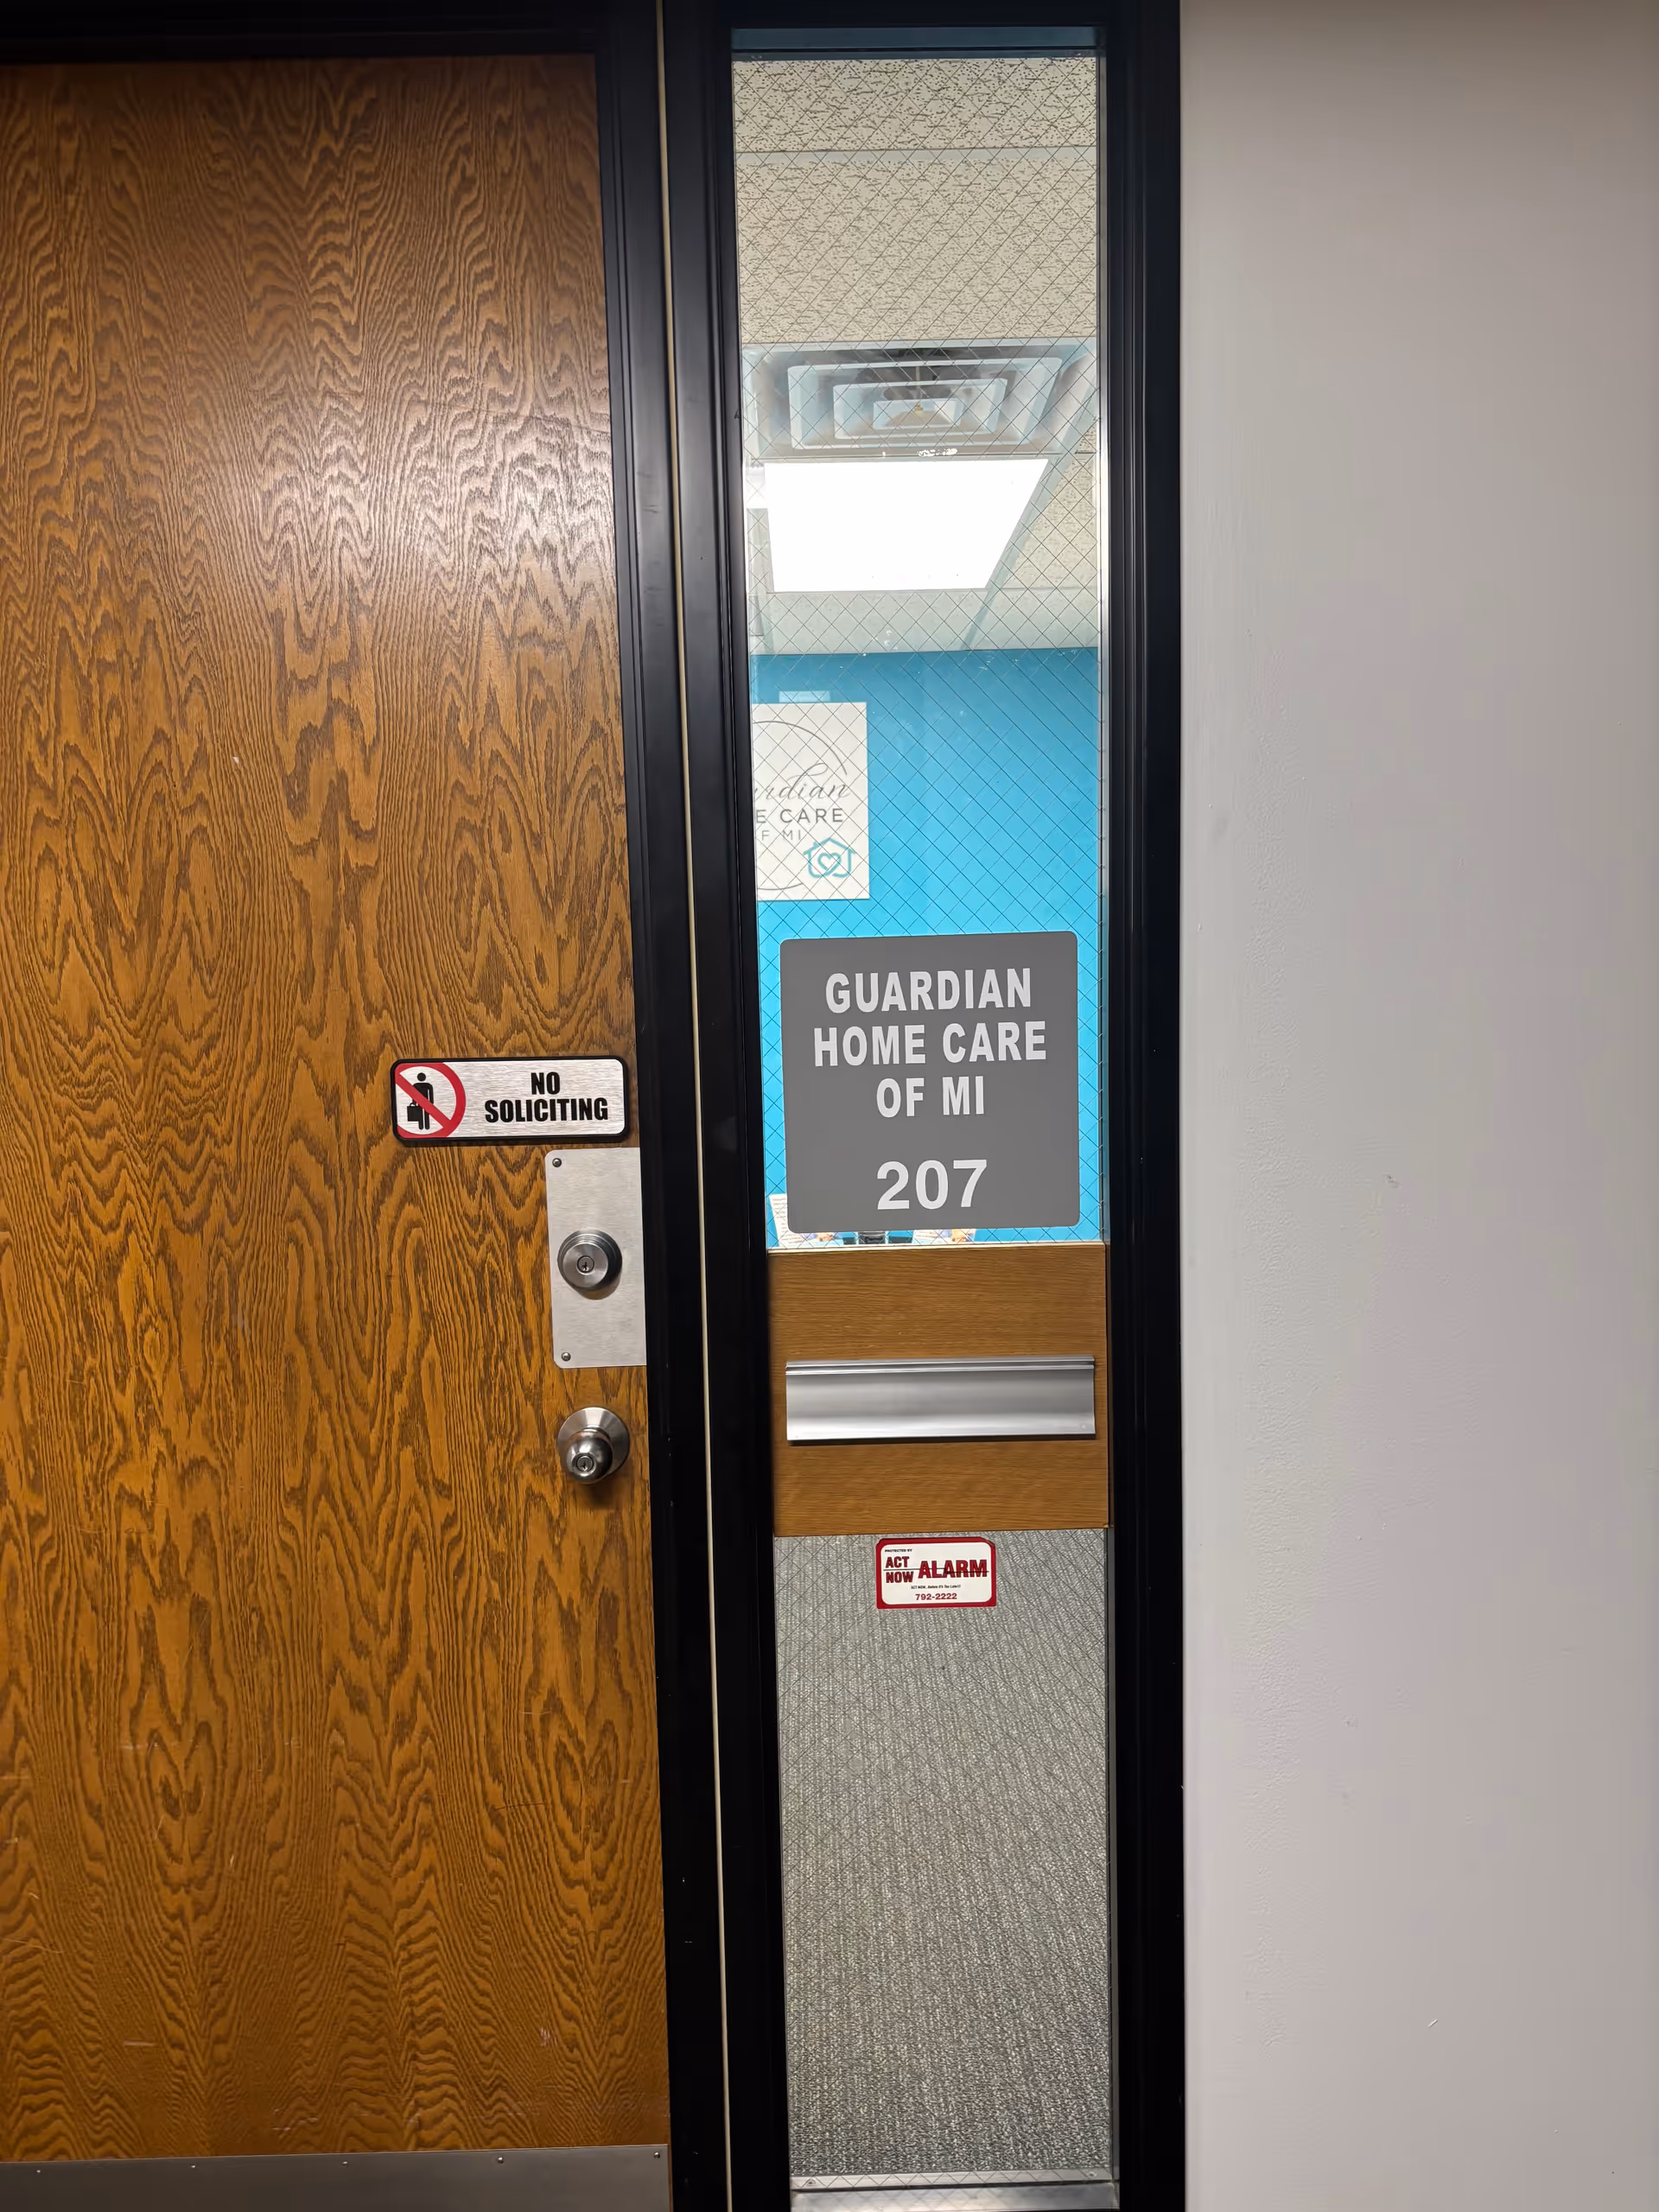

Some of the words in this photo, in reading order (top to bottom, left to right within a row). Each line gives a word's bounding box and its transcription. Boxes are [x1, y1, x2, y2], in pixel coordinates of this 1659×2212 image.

[779, 808, 843, 823] CARE
[782, 830, 801, 841] MI
[826, 968, 1031, 1014] GUARDIAN
[814, 1024, 926, 1067] HOME
[942, 1020, 1046, 1063] CARE
[531, 1071, 561, 1095] NO
[876, 1077, 925, 1118] OF
[942, 1076, 984, 1116] MI
[485, 1097, 608, 1123] SOLICITING
[877, 1159, 988, 1211] 207
[885, 1556, 910, 1568] ACT
[918, 1559, 988, 1579] ALARM
[886, 1571, 914, 1583] NOW
[915, 1592, 957, 1601] 792-2222
